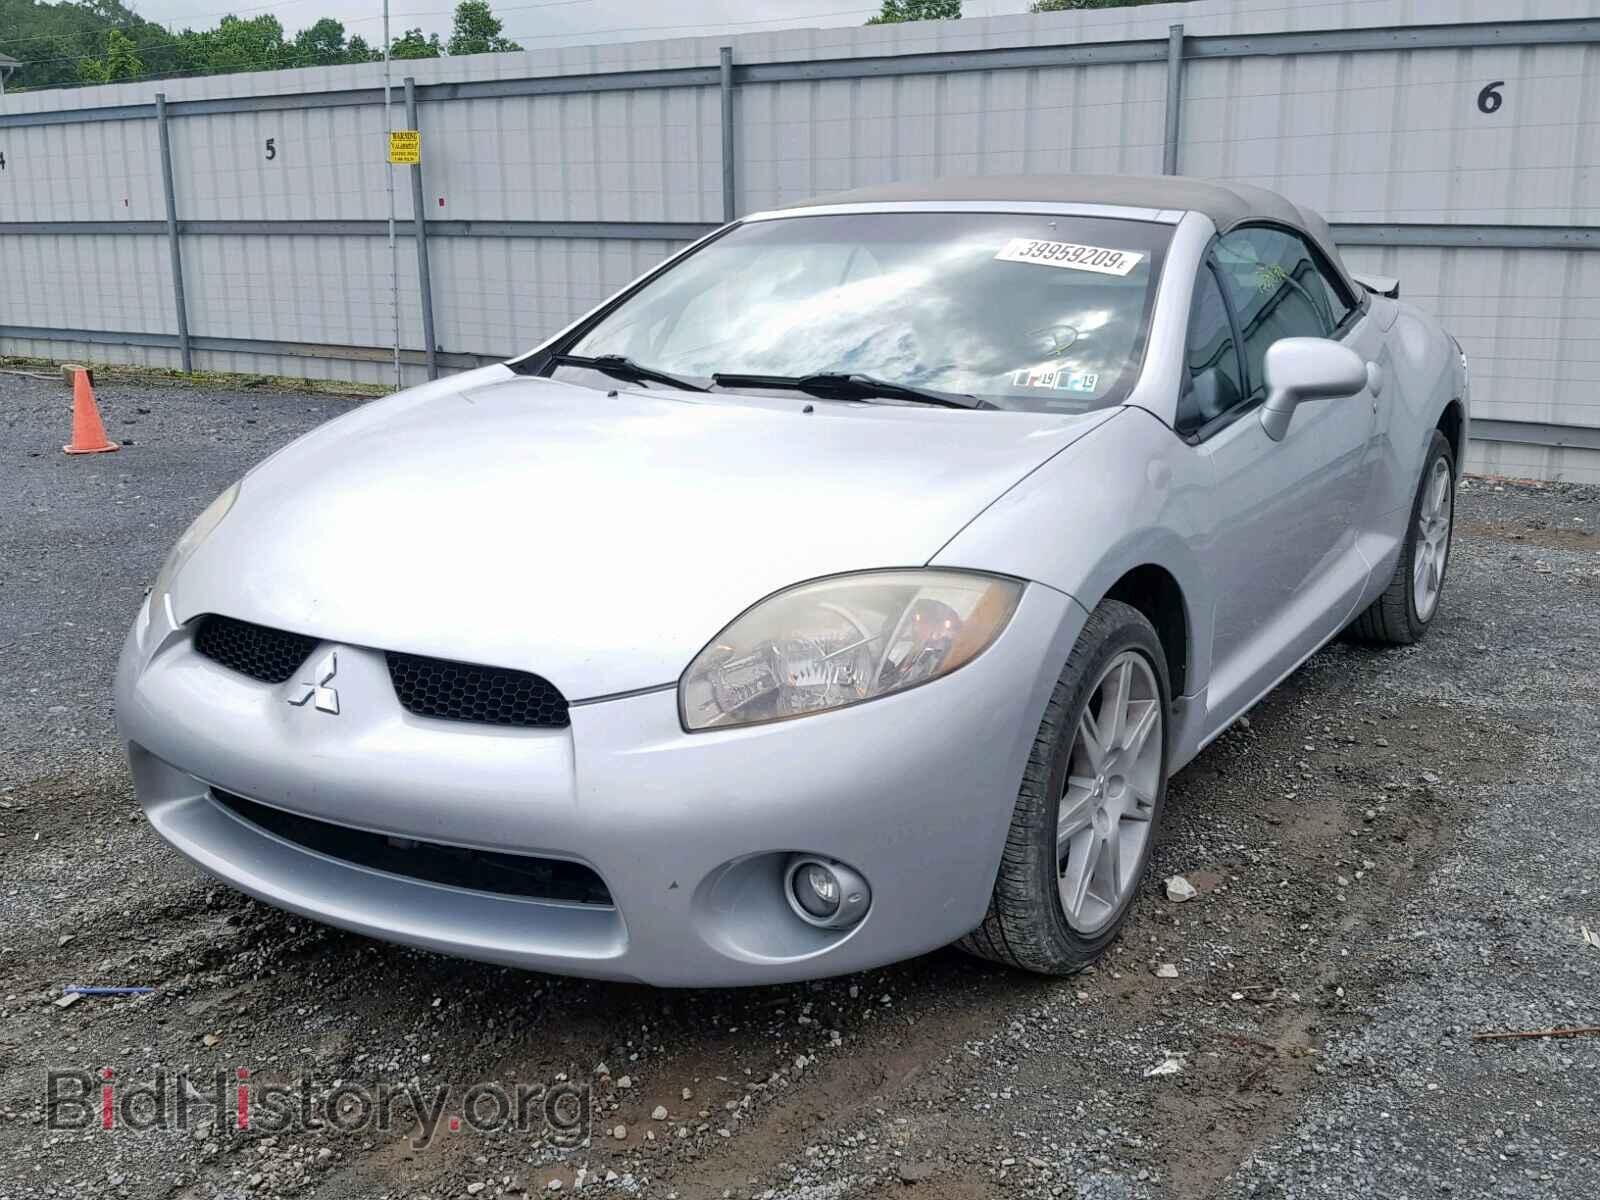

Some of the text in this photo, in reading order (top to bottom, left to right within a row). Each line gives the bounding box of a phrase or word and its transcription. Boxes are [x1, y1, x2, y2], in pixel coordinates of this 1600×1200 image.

[1477, 81, 1504, 114] 6
[265, 138, 276, 160] 5
[1018, 241, 1123, 268] 39959209
[1042, 373, 1054, 385] 19
[1083, 375, 1095, 388] 19
